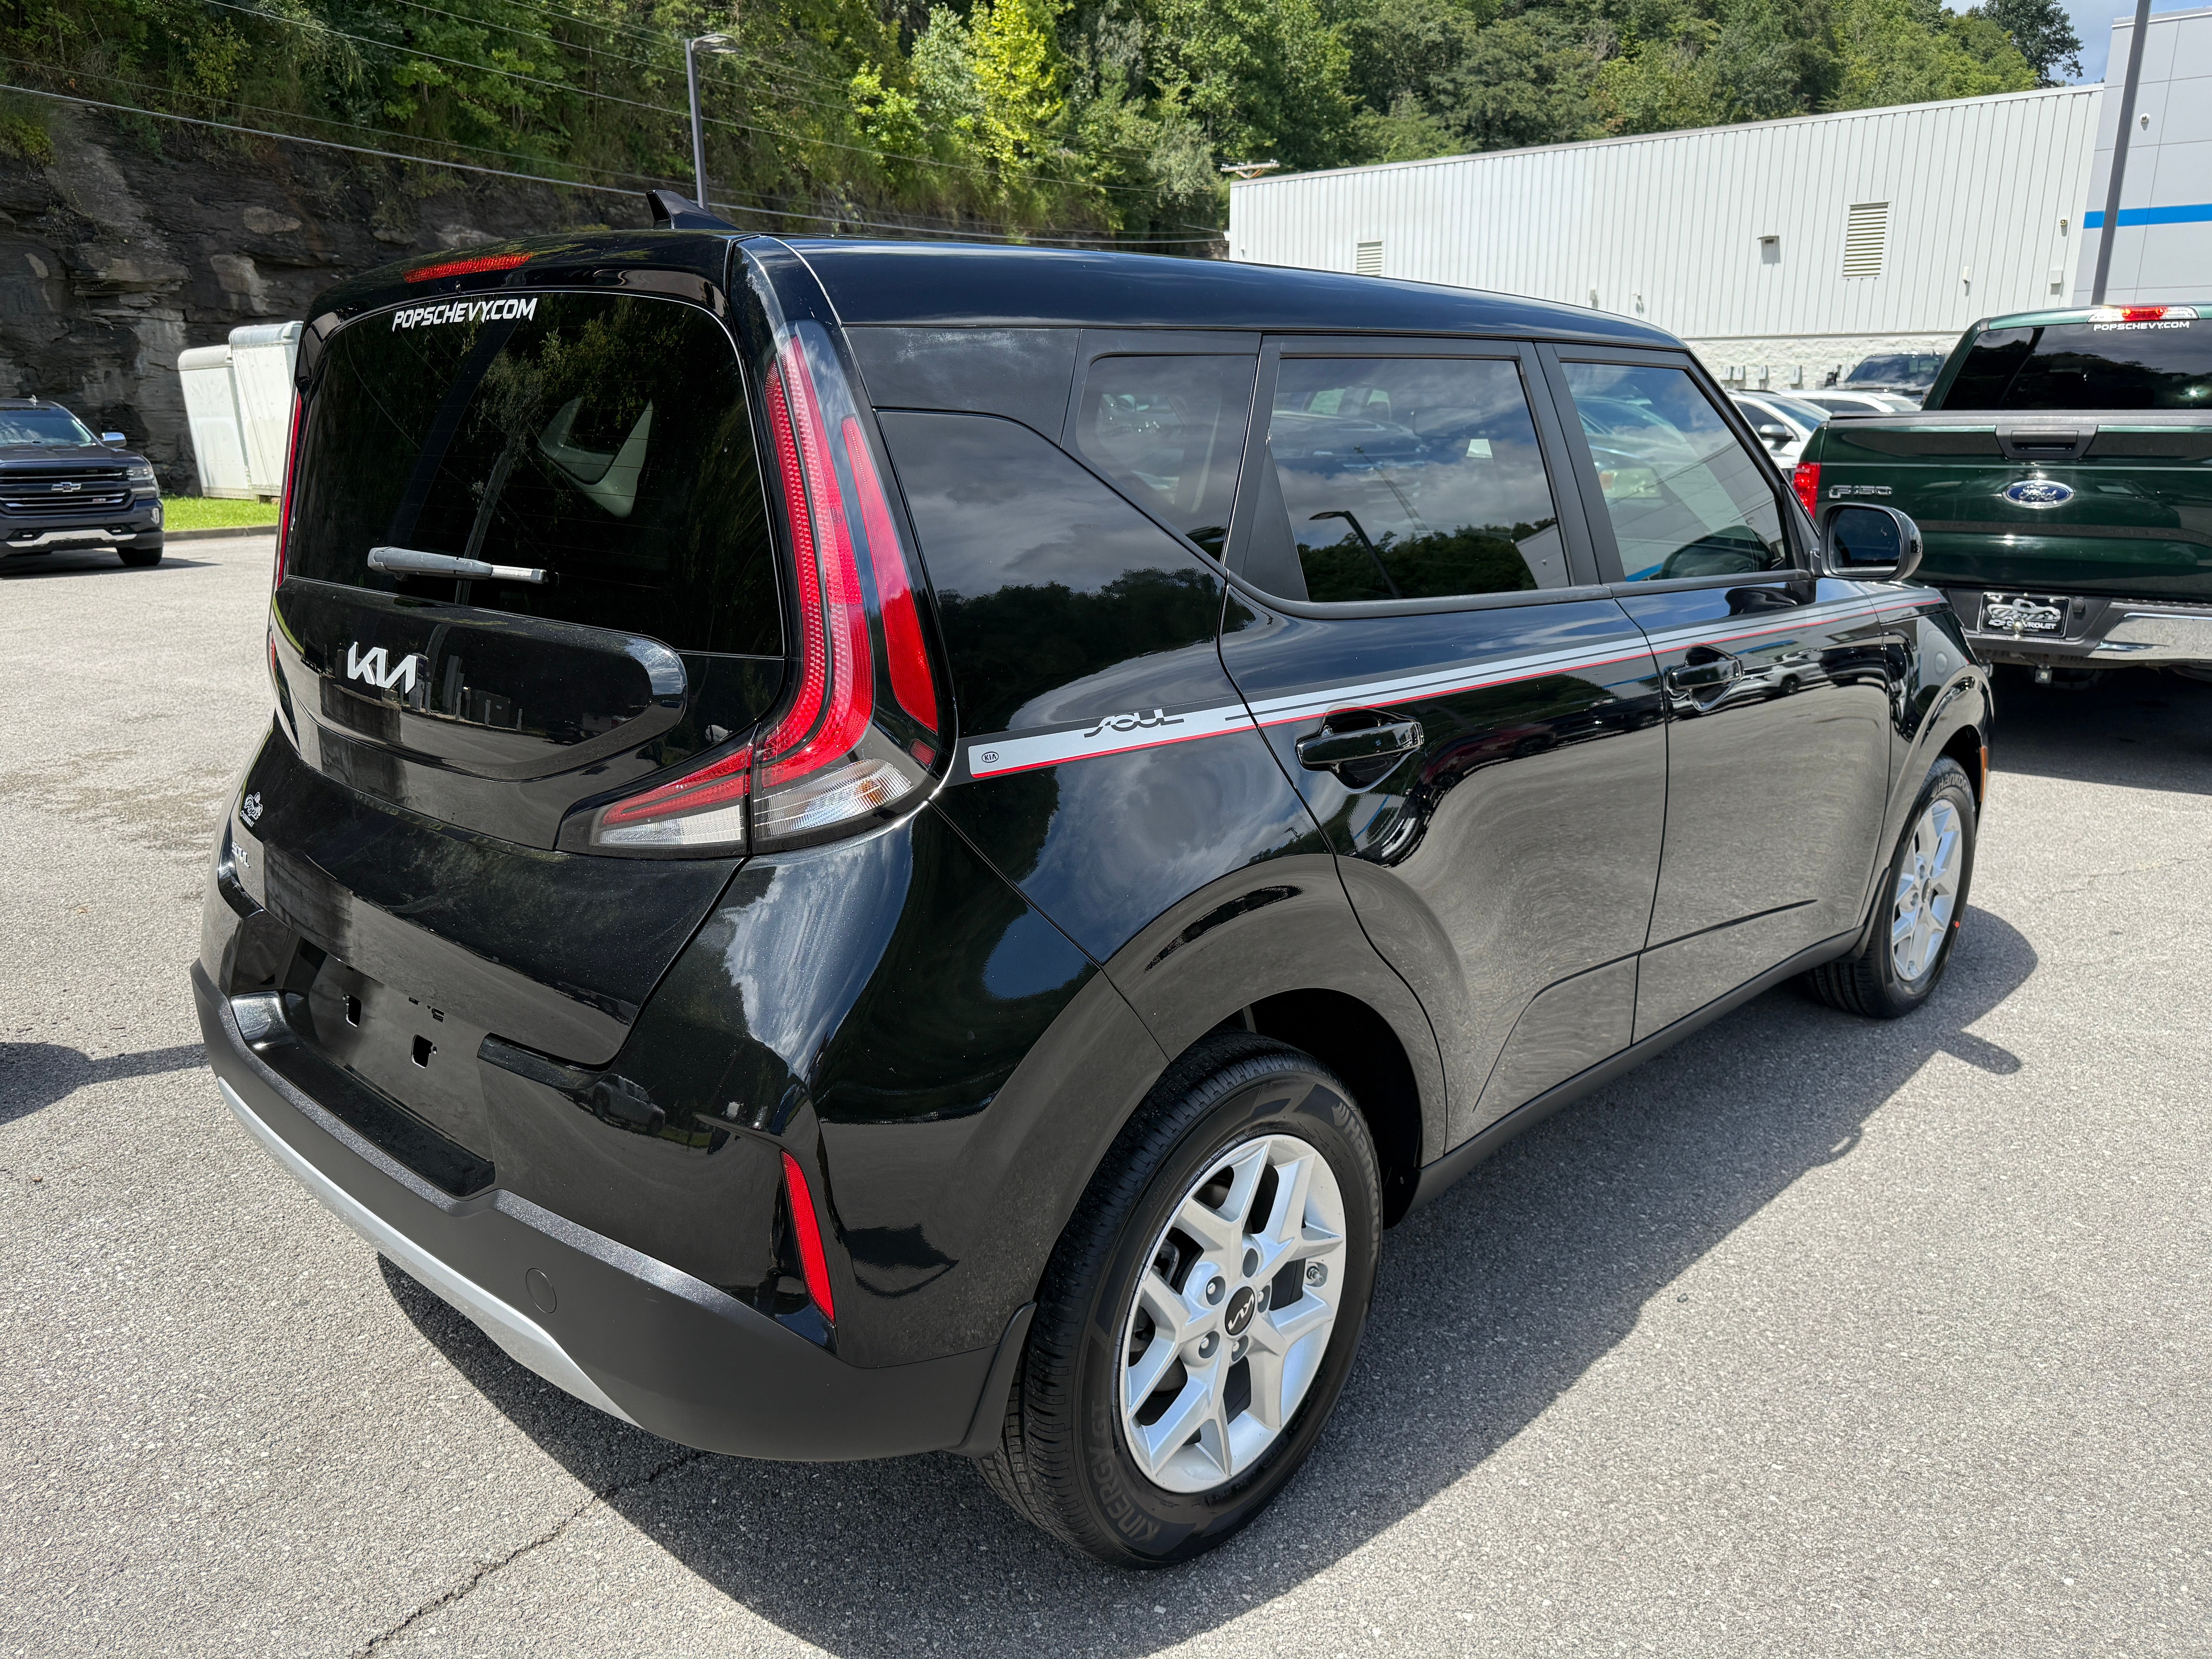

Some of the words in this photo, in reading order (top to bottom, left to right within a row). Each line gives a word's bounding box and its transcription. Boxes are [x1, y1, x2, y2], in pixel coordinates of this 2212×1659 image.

[392, 298, 538, 332] POPSCHEVY.COM
[2094, 321, 2190, 331] POPSCHEVY.COM
[2018, 484, 2058, 501] Ford
[2006, 620, 2056, 629] CVROLET
[348, 641, 418, 694] KIA
[1228, 1293, 1254, 1330] KIA
[1087, 1446, 1161, 1542] KINERGY
